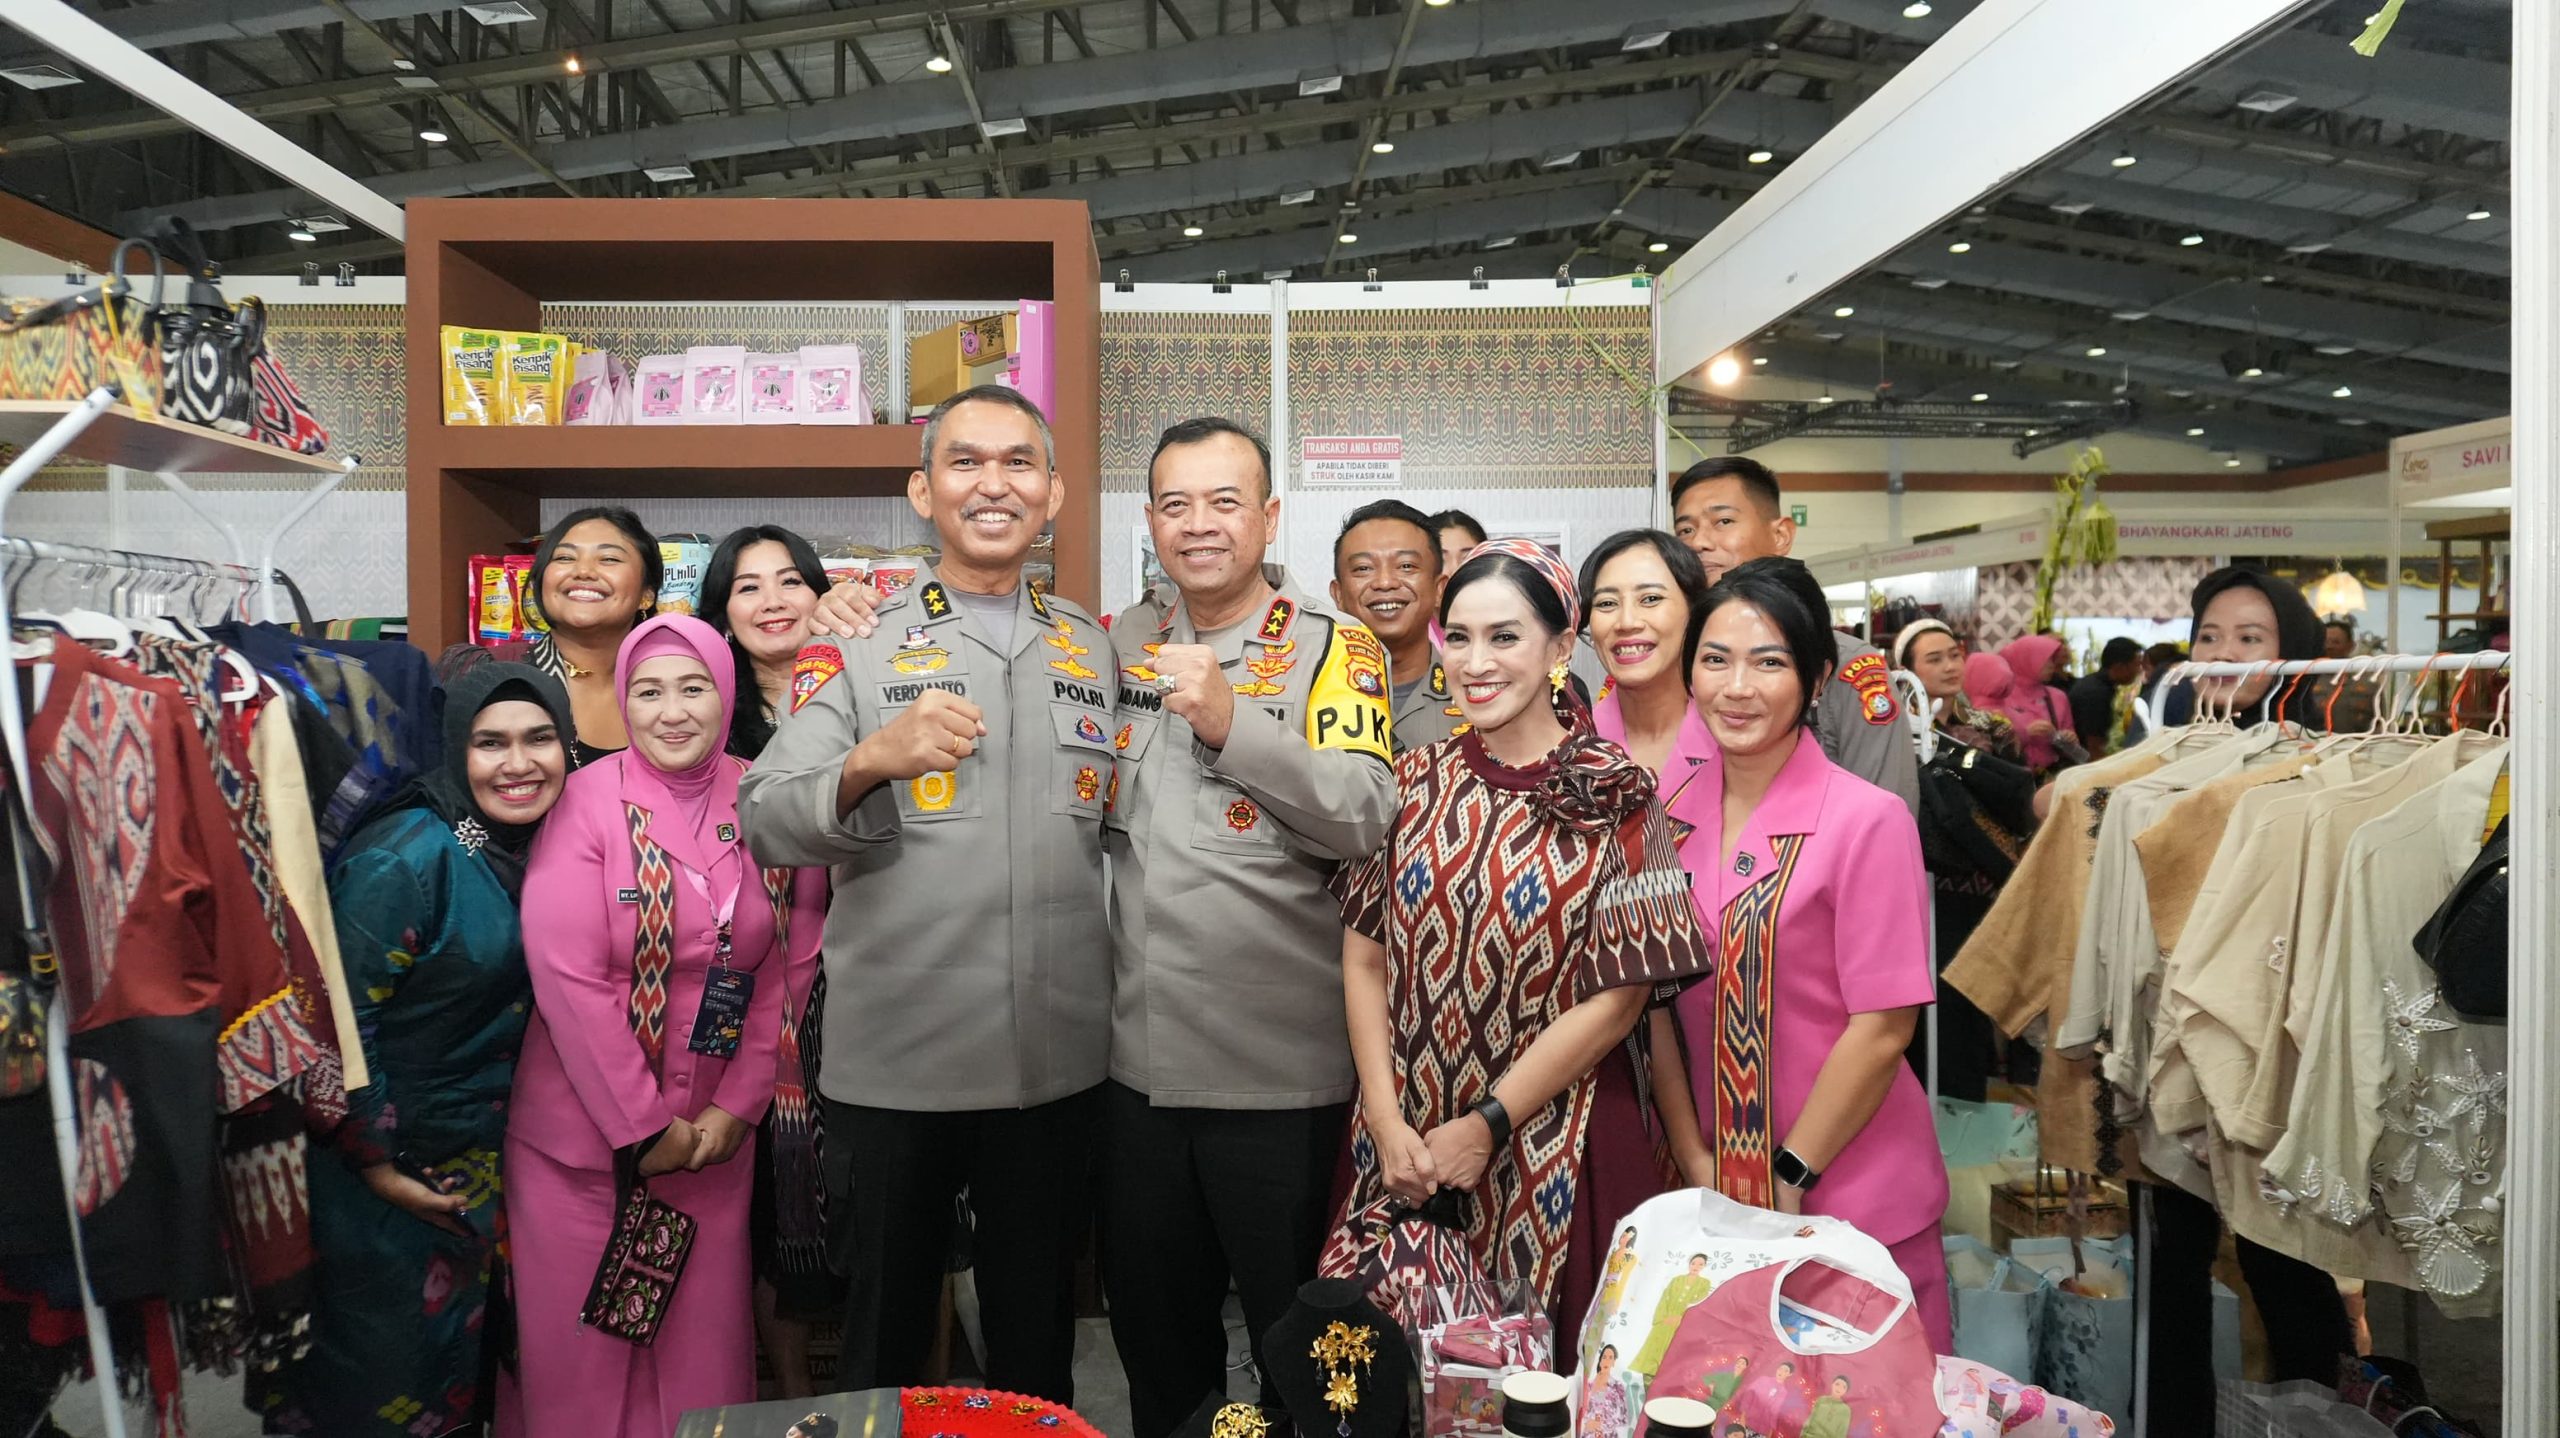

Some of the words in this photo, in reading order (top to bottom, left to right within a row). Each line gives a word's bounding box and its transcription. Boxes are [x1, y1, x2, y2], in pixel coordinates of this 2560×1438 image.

[1305, 442, 1348, 454] TRANSAKSI
[1349, 442, 1371, 454] ANDA
[1372, 442, 1399, 454] GRATIS
[2462, 446, 2500, 469] SAVI
[1316, 462, 1345, 470] APABILA
[1346, 462, 1366, 470] TIDAK
[1367, 462, 1390, 470] DIBERI
[1311, 472, 1336, 480] STRUK
[1337, 472, 1355, 480] OLEH
[1355, 472, 1375, 480] KASIR
[1376, 472, 1395, 480] KAMI
[2119, 525, 2229, 538] BHAYANGKARI
[2233, 525, 2293, 538] JATENG
[1343, 630, 1378, 650] POLDA
[1845, 656, 1882, 678] POLDA
[1053, 680, 1106, 709] POLRI
